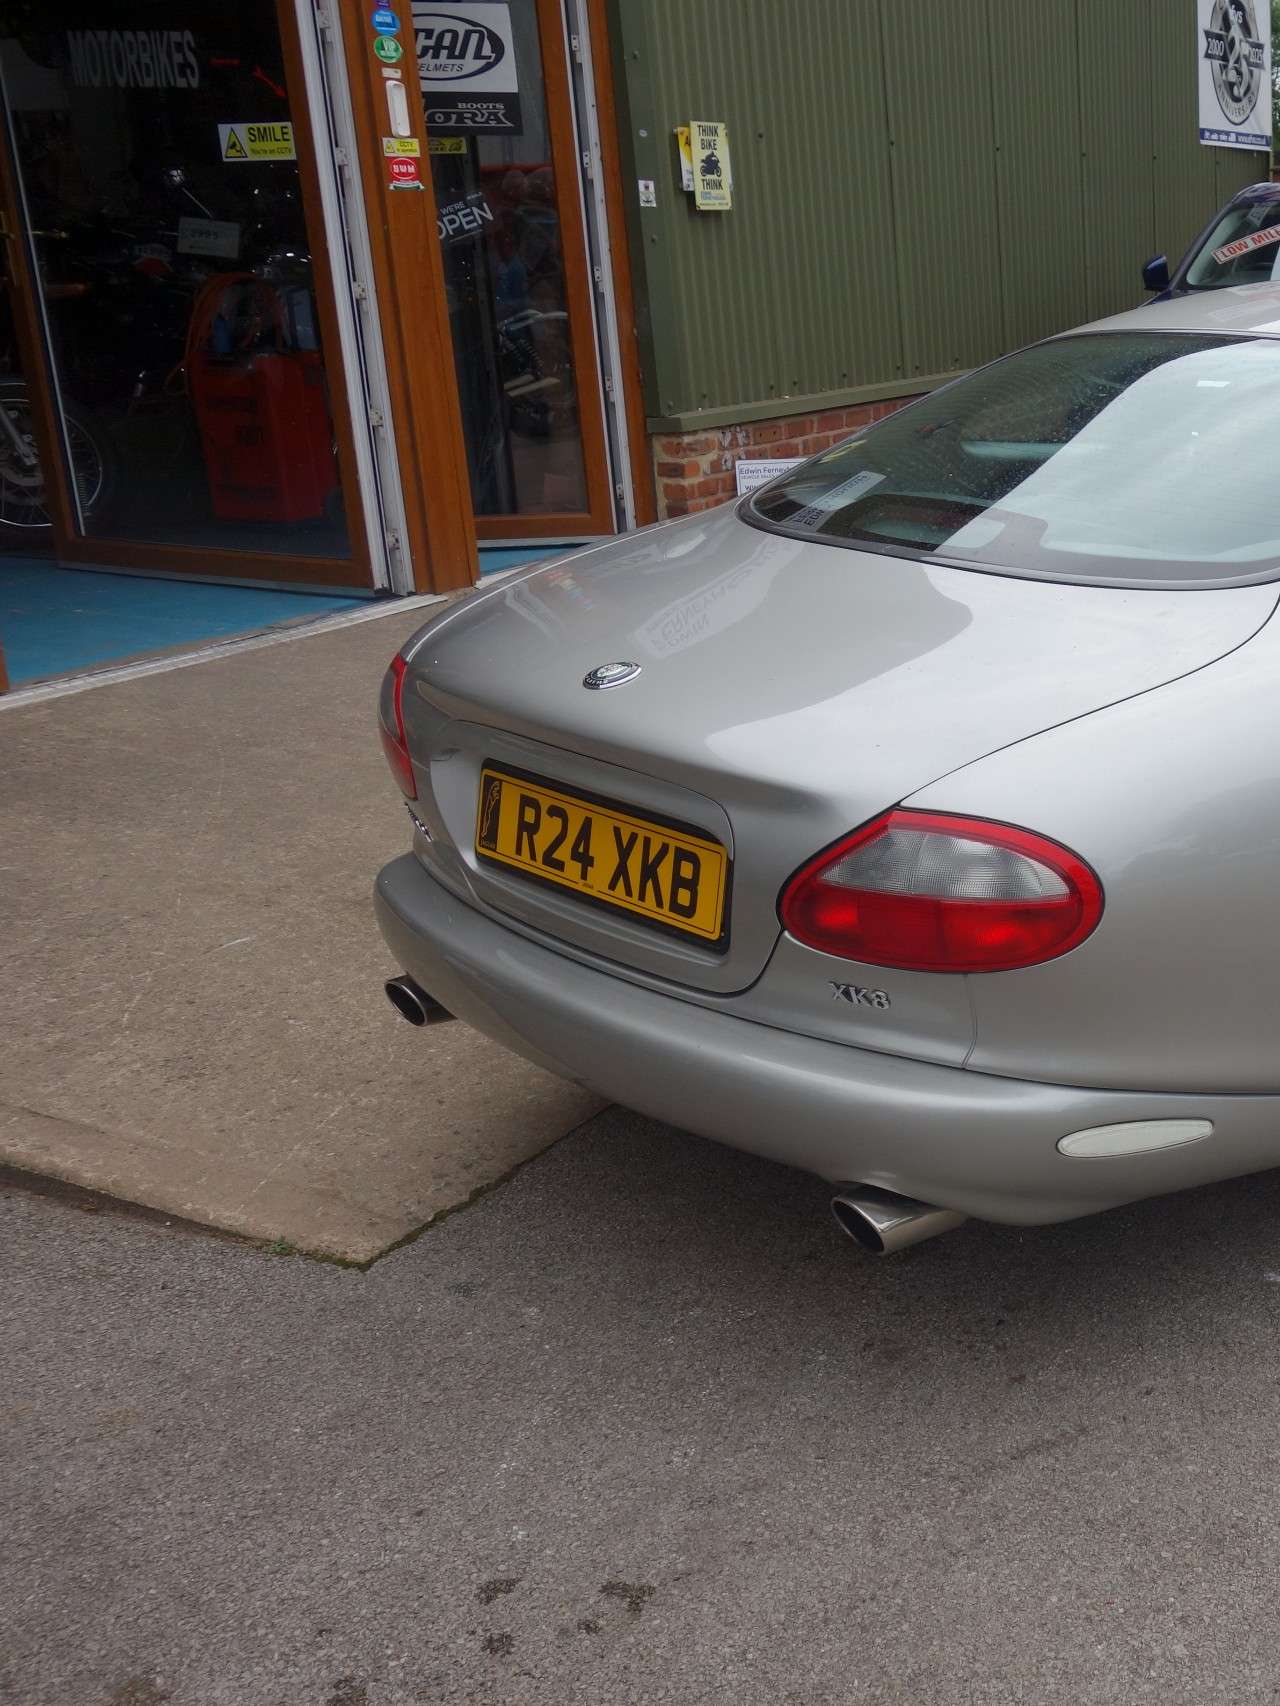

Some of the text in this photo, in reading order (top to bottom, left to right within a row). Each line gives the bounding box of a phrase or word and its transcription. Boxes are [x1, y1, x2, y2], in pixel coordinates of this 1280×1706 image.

[66, 30, 200, 88] MOTORBIKES
[419, 63, 465, 73] ELMETS
[456, 102, 505, 110] BOOTS
[247, 126, 290, 143] SMILE
[697, 124, 719, 138] THINK
[700, 138, 718, 150] BIKE
[701, 179, 723, 191] THINK
[1220, 240, 1249, 259] LOW
[740, 467, 762, 475] Edwin
[515, 793, 595, 881] R24
[608, 825, 701, 919] XKB
[828, 981, 890, 1010] XK8
